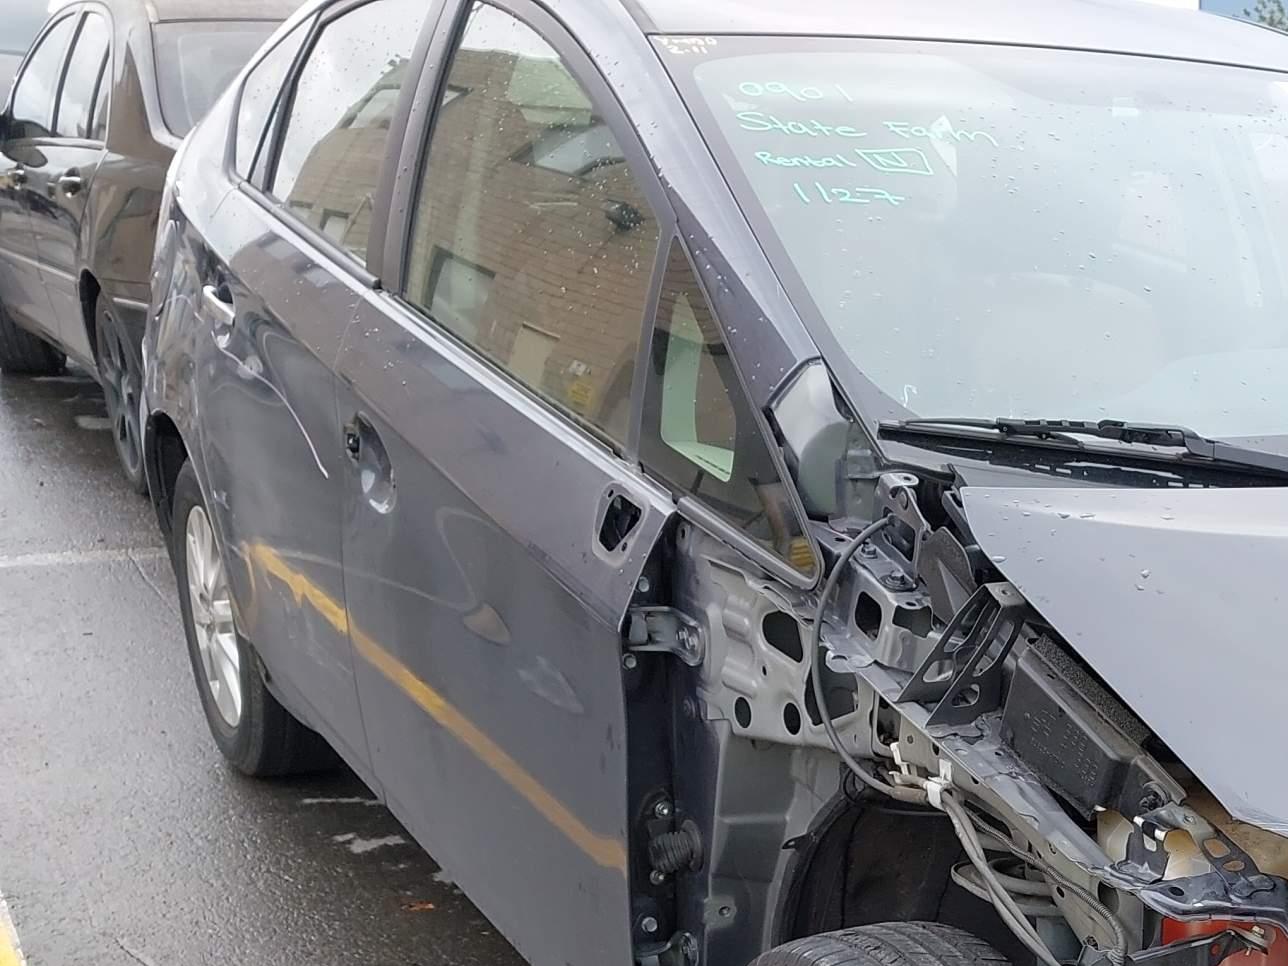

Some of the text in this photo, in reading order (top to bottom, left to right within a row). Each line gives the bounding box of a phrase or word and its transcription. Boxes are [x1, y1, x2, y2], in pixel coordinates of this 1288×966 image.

[735, 112, 999, 147] State Farm
[755, 152, 857, 168] Rental
[793, 182, 905, 205] 1127
